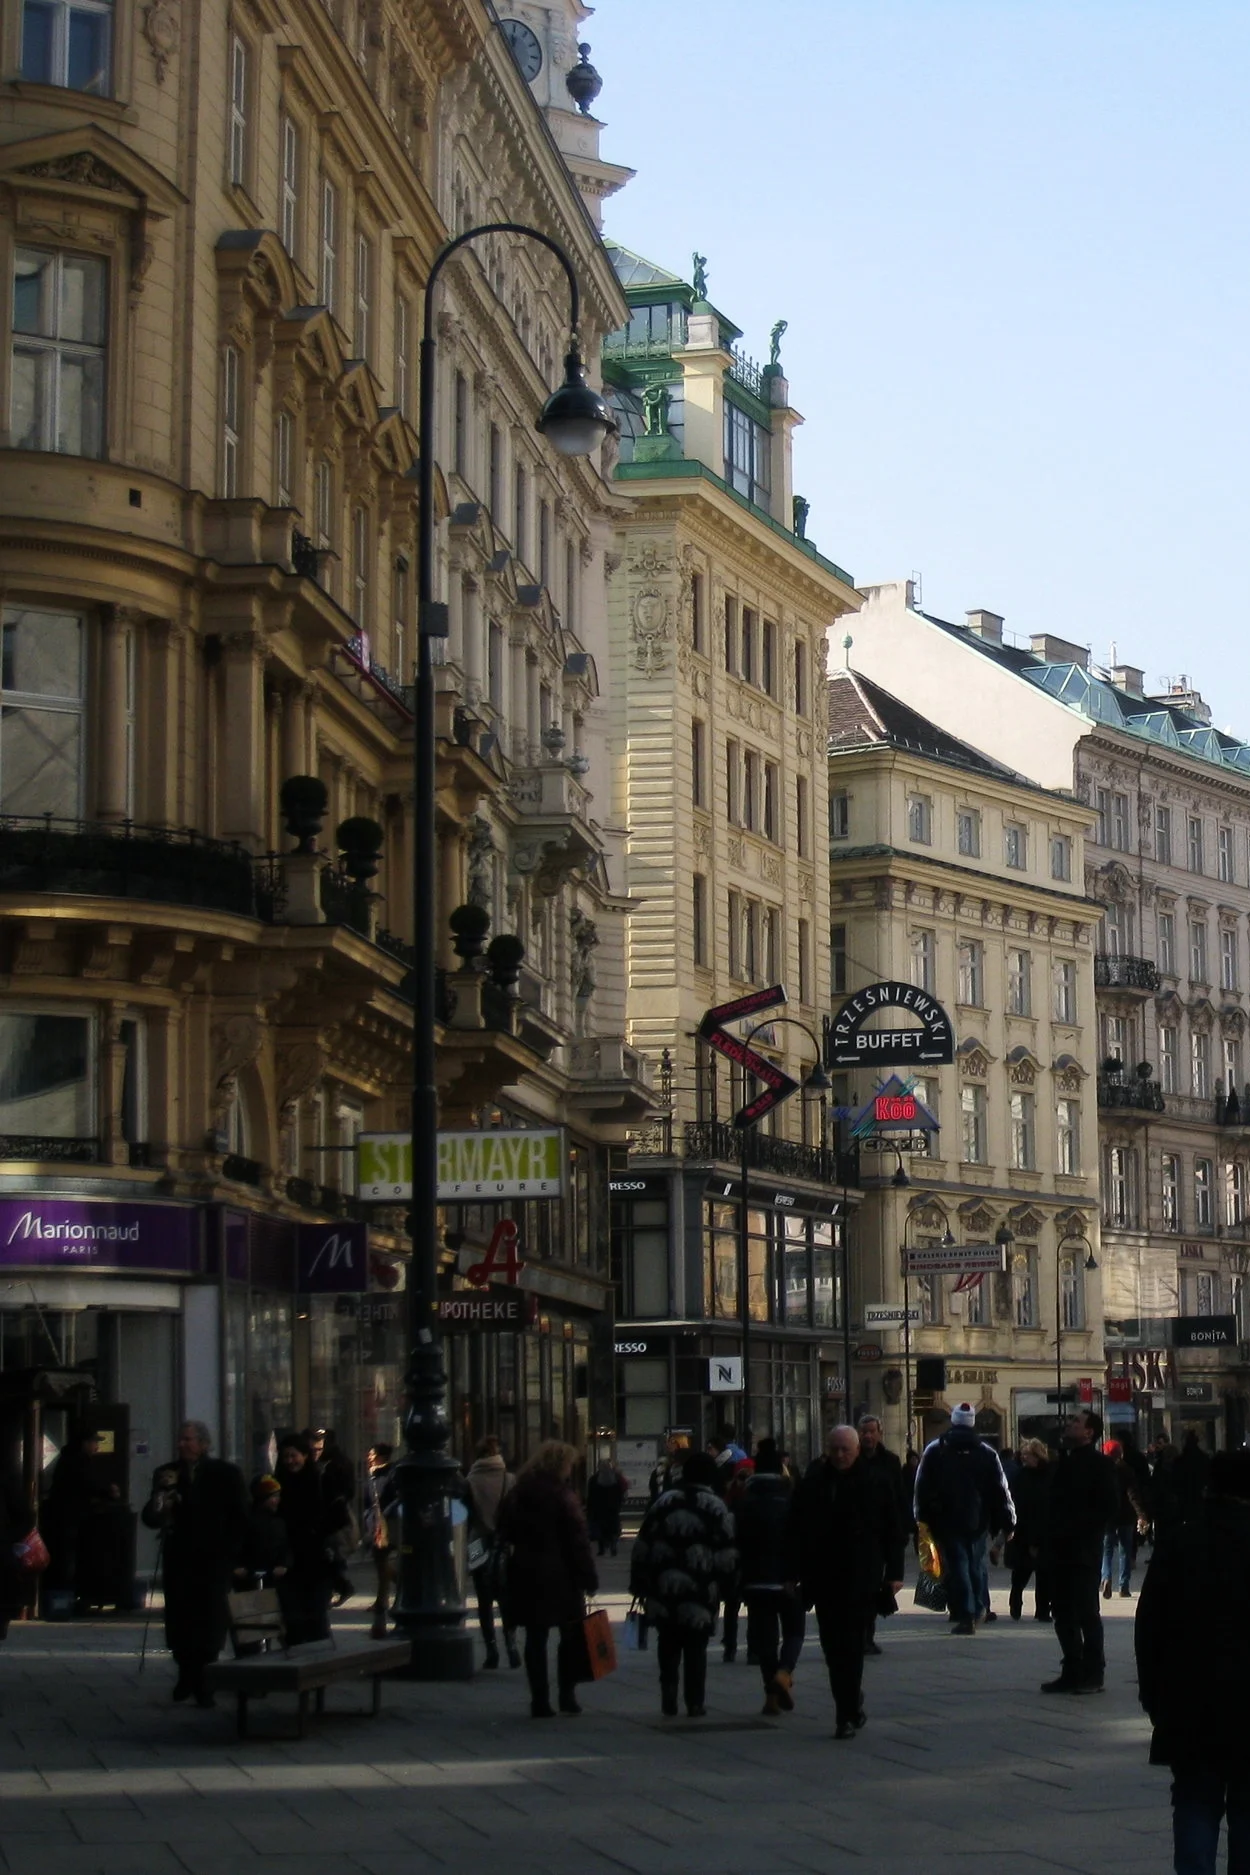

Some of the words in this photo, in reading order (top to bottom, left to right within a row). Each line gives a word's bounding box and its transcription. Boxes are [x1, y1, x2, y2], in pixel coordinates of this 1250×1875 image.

[835, 986, 946, 1047] TRZEŚNIEWSKI
[856, 1032, 923, 1049] BUFFET
[371, 1137, 547, 1183] STRMAYR
[371, 1182, 548, 1194] COFEURE
[608, 1181, 647, 1191] RESSO
[6, 1211, 140, 1246] Marionnaud
[62, 1245, 99, 1255] PARIS
[826, 1376, 845, 1391] FOSSI
